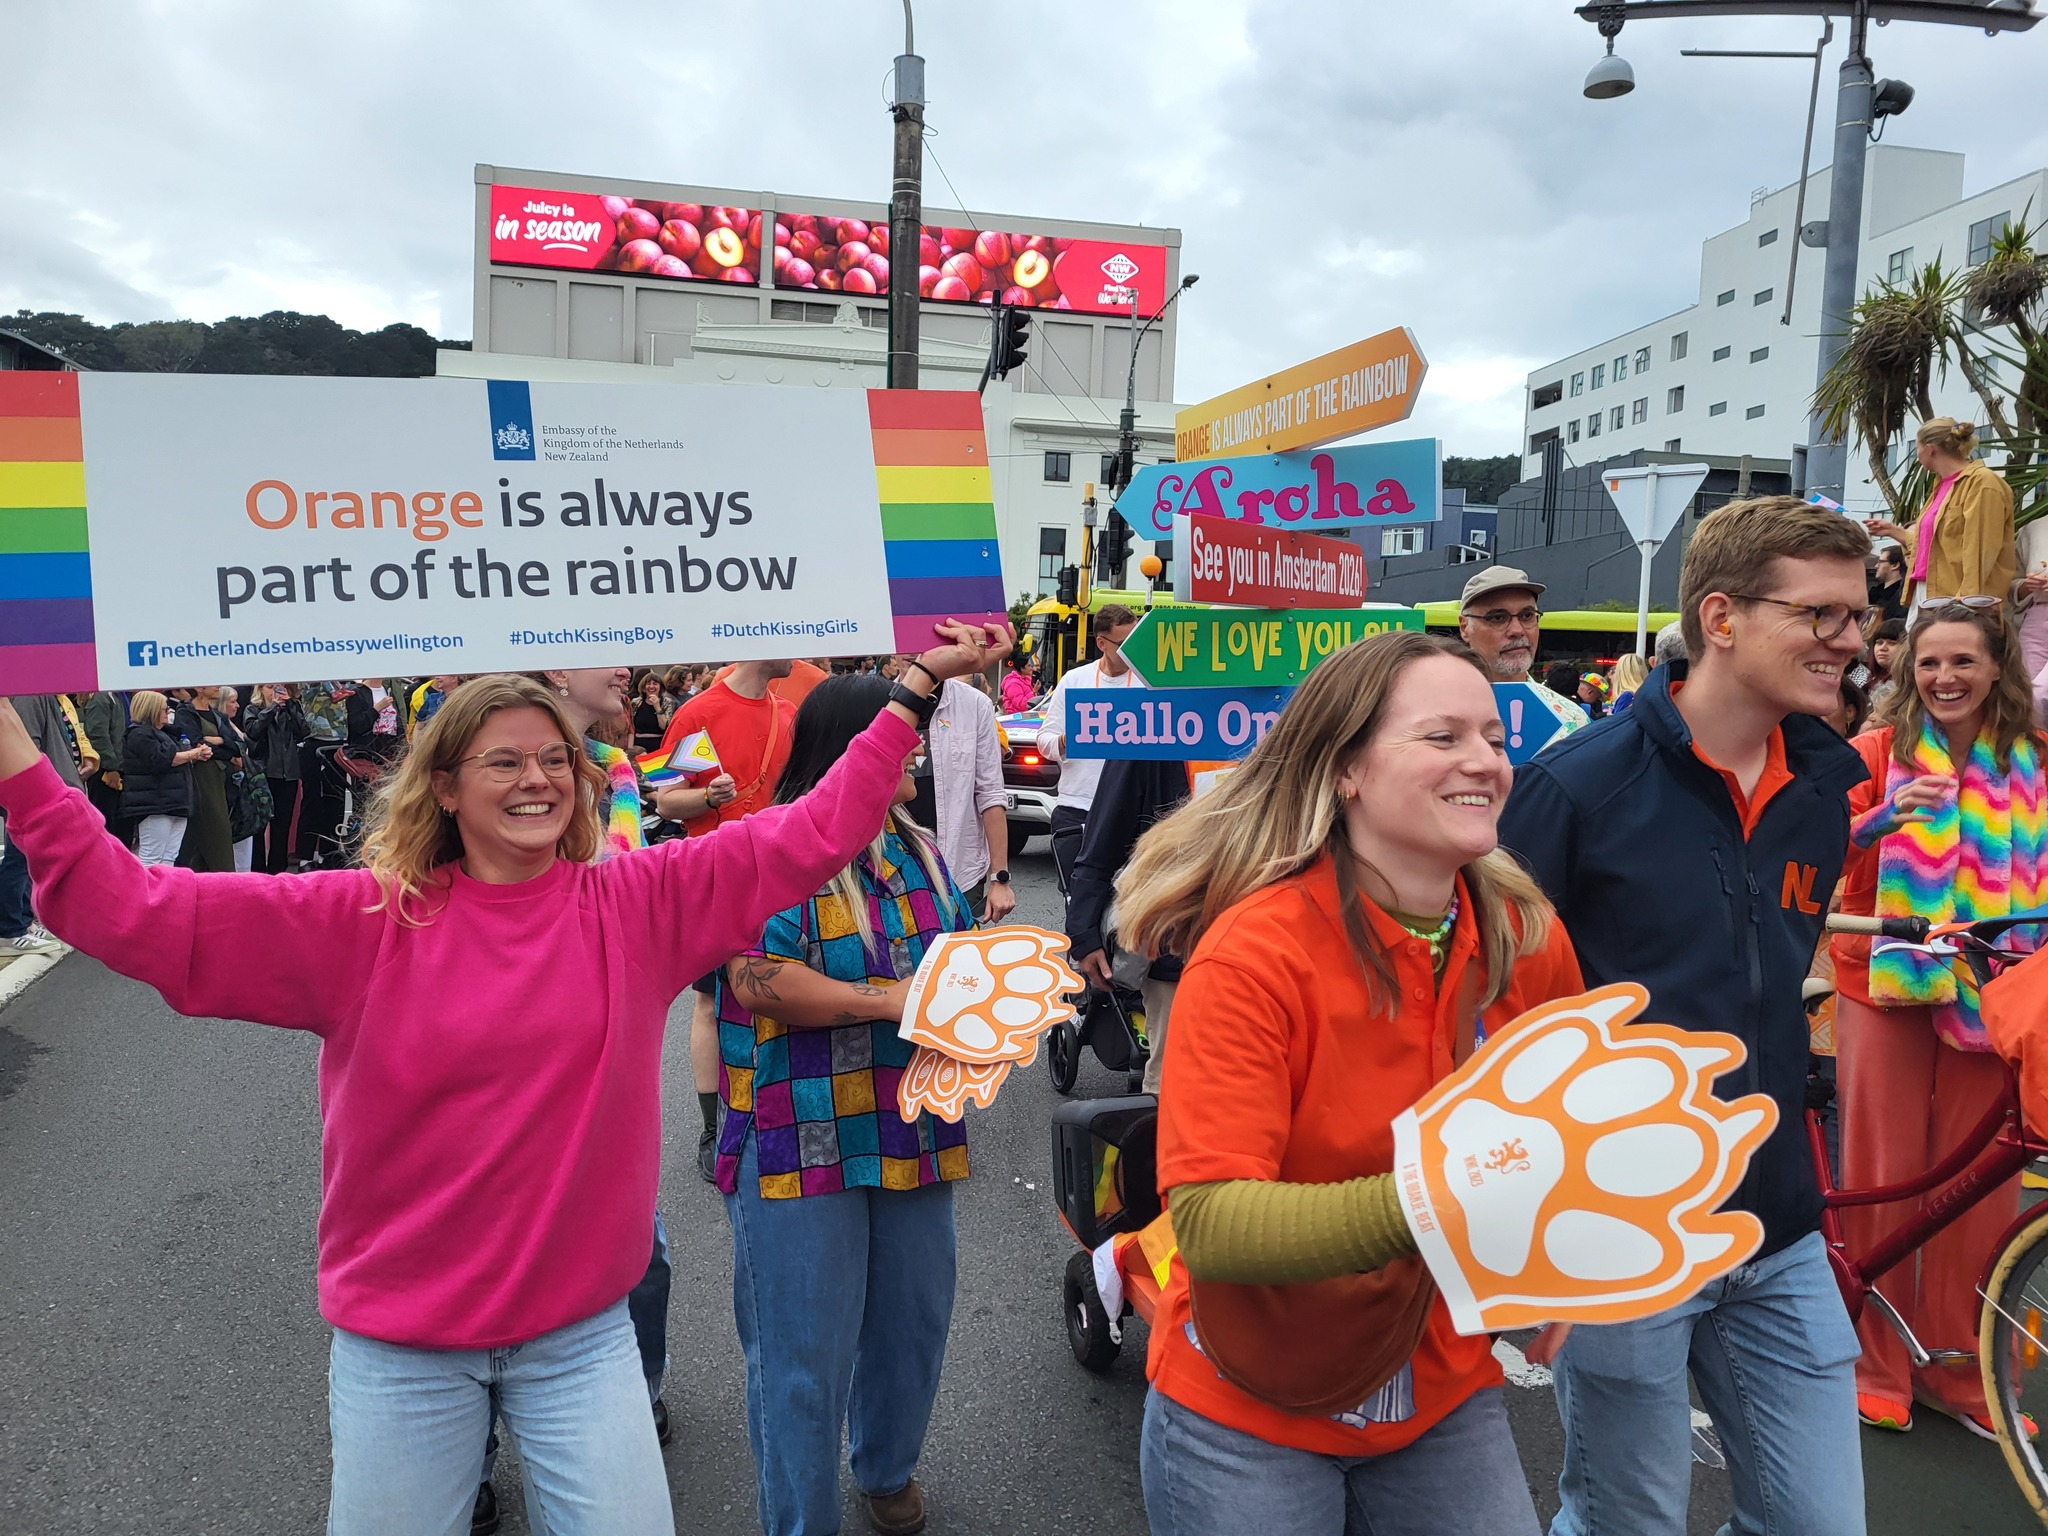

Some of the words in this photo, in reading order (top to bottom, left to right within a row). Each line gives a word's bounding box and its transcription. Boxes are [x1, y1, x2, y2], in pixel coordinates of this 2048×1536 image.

[522, 200, 561, 218] Juicy
[562, 203, 575, 217] is
[495, 213, 520, 241] in
[523, 219, 602, 243] season
[1109, 263, 1131, 274] NW
[1176, 423, 1210, 463] ORANGE
[1211, 416, 1221, 452] IS
[1222, 404, 1263, 449] ALWAYS
[1265, 392, 1294, 435] PART
[1296, 387, 1311, 426] OF
[1313, 377, 1339, 420] THE
[1341, 353, 1410, 412] RAINBOW
[542, 425, 585, 438] Embassy
[587, 425, 599, 435] of
[600, 425, 617, 436] the
[543, 438, 591, 450] Kingdom
[592, 438, 605, 449] of
[605, 438, 622, 449] the
[624, 439, 684, 449] Netherlands
[544, 452, 567, 462] New
[568, 451, 609, 462] Zealand
[245, 479, 484, 542] Orange
[498, 477, 545, 528] is
[559, 478, 753, 538] always
[1151, 453, 1416, 531] Aroha
[1192, 526, 1223, 582] See
[1227, 544, 1254, 597] you
[1257, 536, 1271, 587] in
[1273, 539, 1337, 594] Amsterdam
[1338, 551, 1364, 598] 2026!
[216, 556, 356, 620] part
[370, 548, 436, 601] of
[448, 547, 550, 599] the
[567, 545, 798, 597] rainbow
[160, 633, 464, 660] netherlandsembassywellington
[509, 625, 674, 646] #DutchKissingBoys
[711, 619, 858, 639] #DutchKissingGirls
[1156, 621, 1198, 672] WE
[1211, 621, 1282, 672] LOVE
[1074, 701, 1204, 746] Hallo
[1781, 860, 1821, 915] NL
[1926, 1171, 1982, 1219] LEKKER
